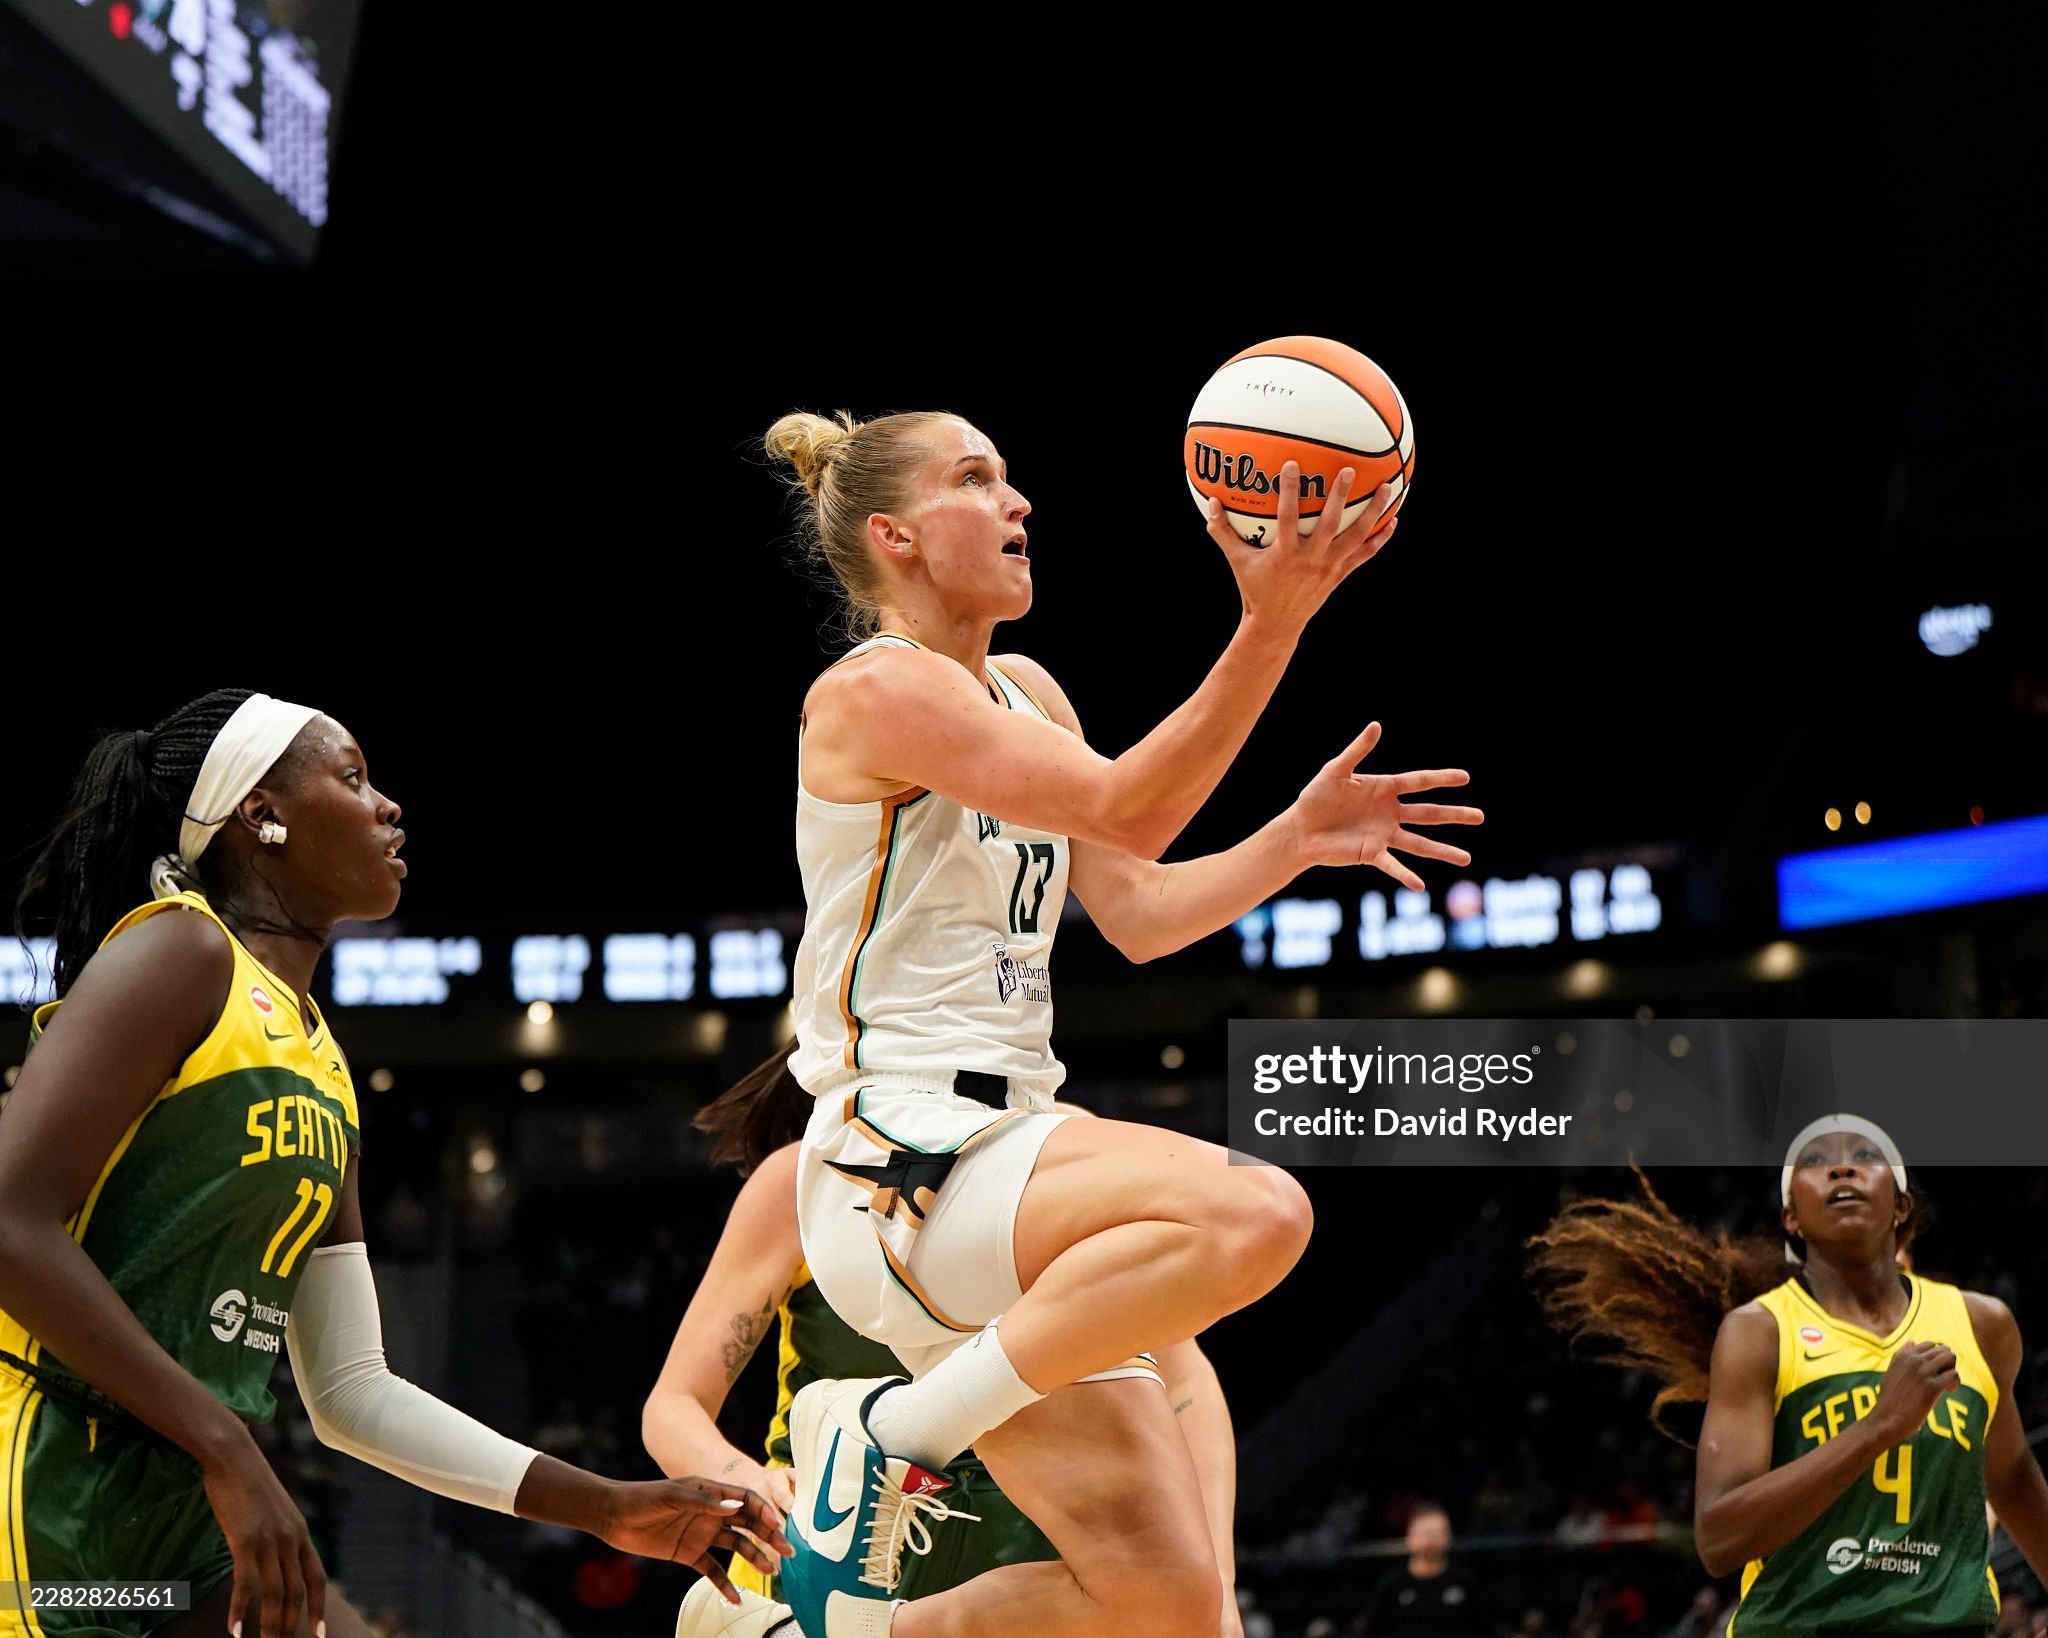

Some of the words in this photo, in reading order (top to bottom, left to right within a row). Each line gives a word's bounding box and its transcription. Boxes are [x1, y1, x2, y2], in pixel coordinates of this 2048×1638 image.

[1008, 842, 1055, 935] 13
[260, 1177, 333, 1278] 11
[1872, 1444, 1913, 1525] 4
[1863, 1556, 1921, 1575] SWEDISH
[1867, 1534, 1941, 1558] Prodence
